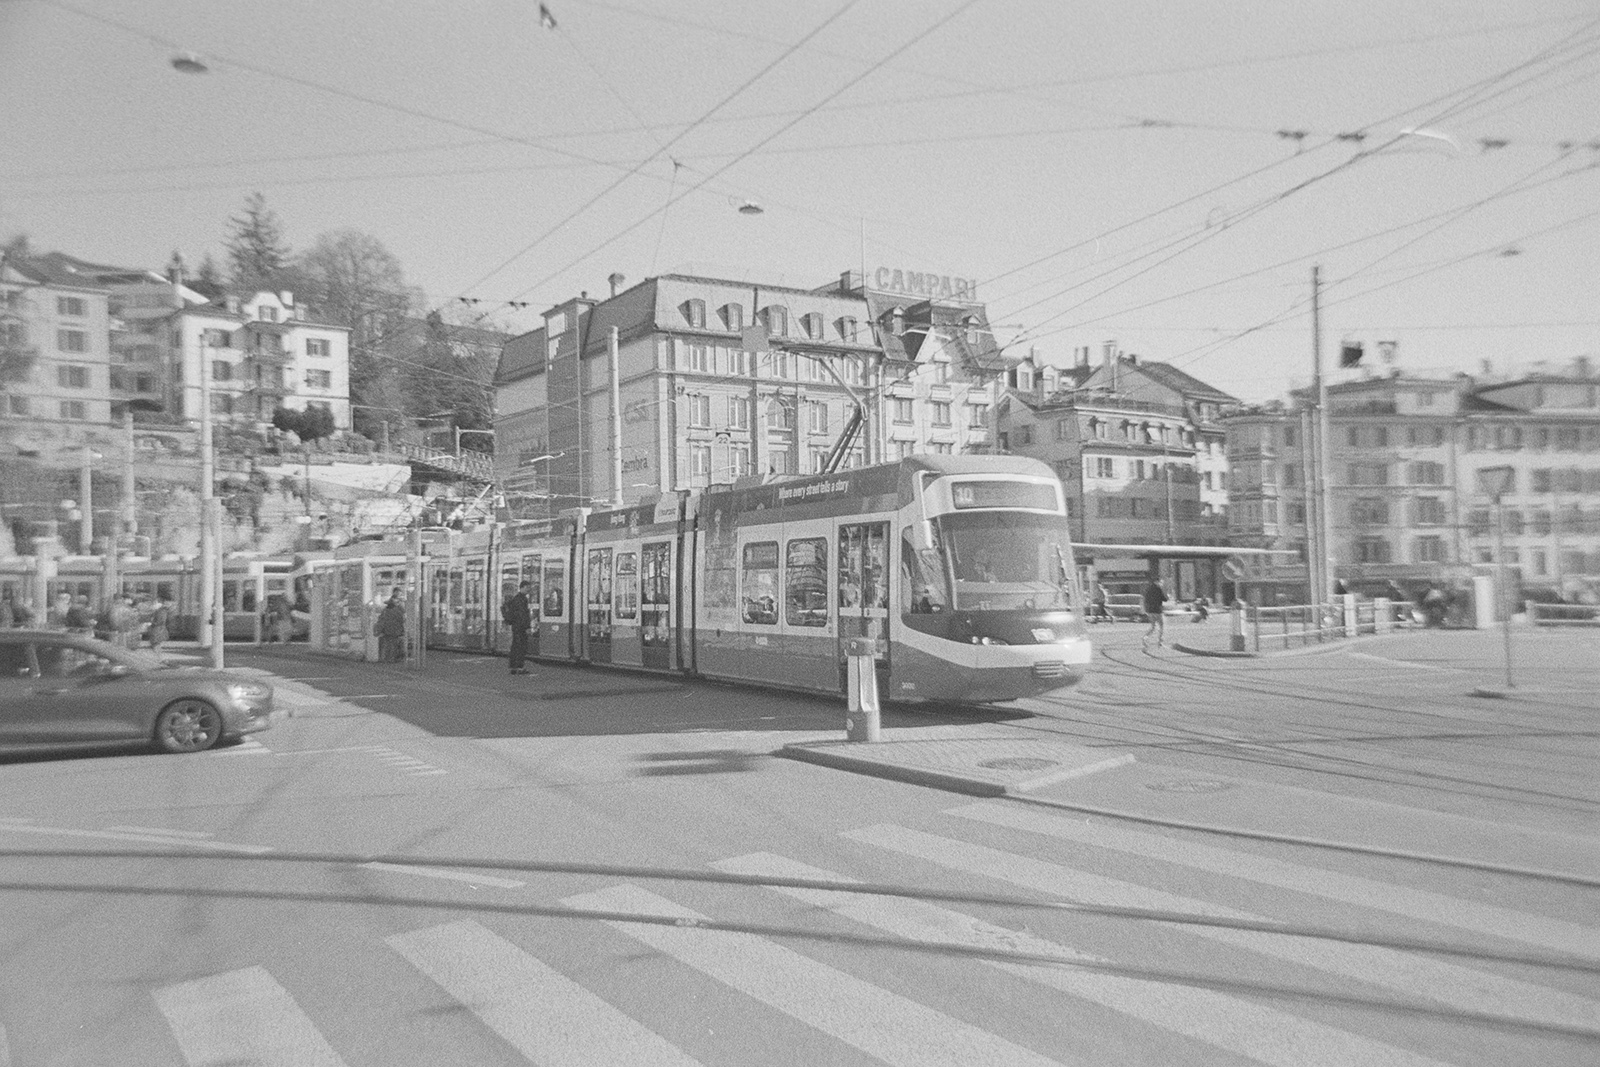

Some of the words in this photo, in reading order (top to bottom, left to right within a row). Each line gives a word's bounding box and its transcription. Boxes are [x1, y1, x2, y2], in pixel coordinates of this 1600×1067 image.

[875, 266, 976, 300] CAMPARI
[793, 486, 806, 499] every
[806, 484, 820, 496] street
[836, 479, 850, 493] story
